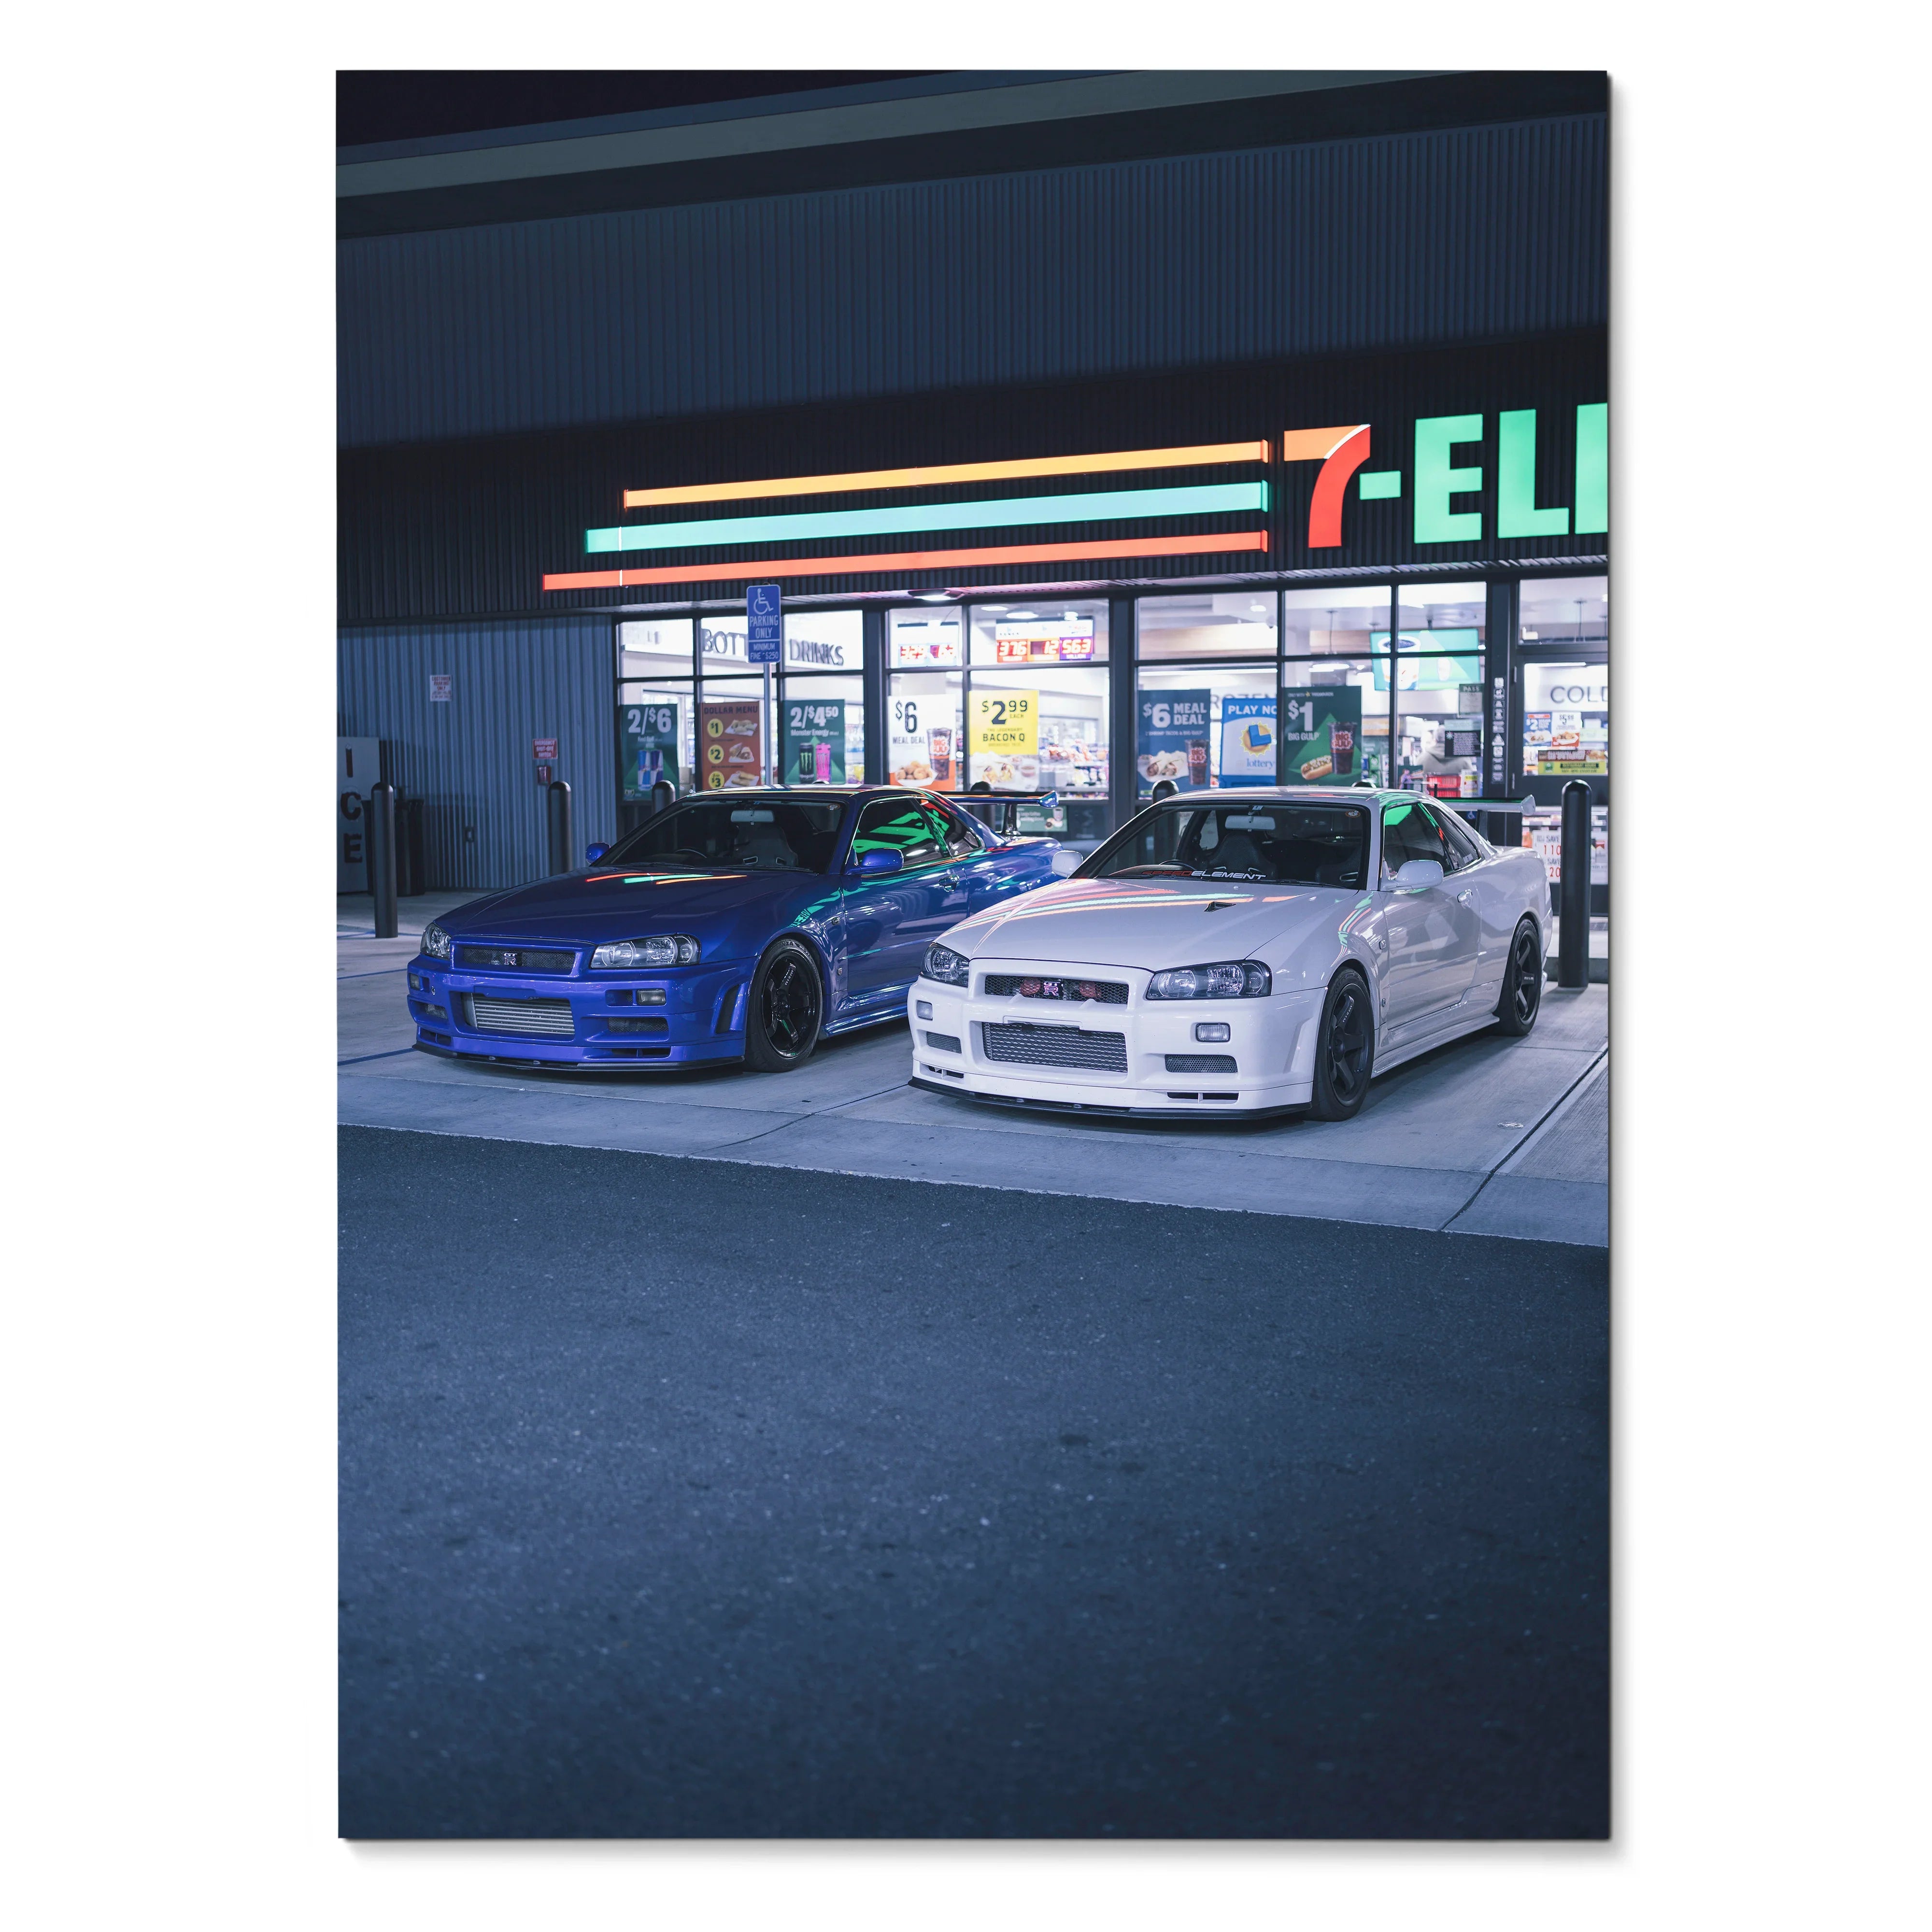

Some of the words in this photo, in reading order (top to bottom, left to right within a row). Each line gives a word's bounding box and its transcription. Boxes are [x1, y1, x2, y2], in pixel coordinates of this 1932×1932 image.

[750, 615, 779, 626] PARKING
[755, 627, 773, 639] ONLY
[790, 639, 844, 666] DRINKS
[999, 641, 1027, 656] 376
[1044, 640, 1059, 654] 12
[1062, 639, 1092, 654] 563
[765, 652, 779, 660] $250
[704, 706, 733, 714] DOLLAR
[736, 706, 758, 714] MENU
[1142, 702, 1171, 728] $6
[1173, 702, 1207, 714] MEAL
[1228, 705, 1259, 715] PLAY
[1288, 699, 1313, 732] $1
[627, 707, 672, 735] 2/$6
[895, 700, 917, 733] $6
[1173, 713, 1206, 725] DEAL
[711, 722, 719, 734] $1
[893, 736, 909, 744] MEAL
[910, 736, 926, 744] DEAL
[982, 733, 1015, 742] BACON
[1019, 733, 1025, 742] Q
[1288, 732, 1300, 741] BIG
[1300, 732, 1320, 741] GULP
[710, 749, 721, 760] $2
[1246, 758, 1274, 770] lottery
[711, 777, 721, 787] $3
